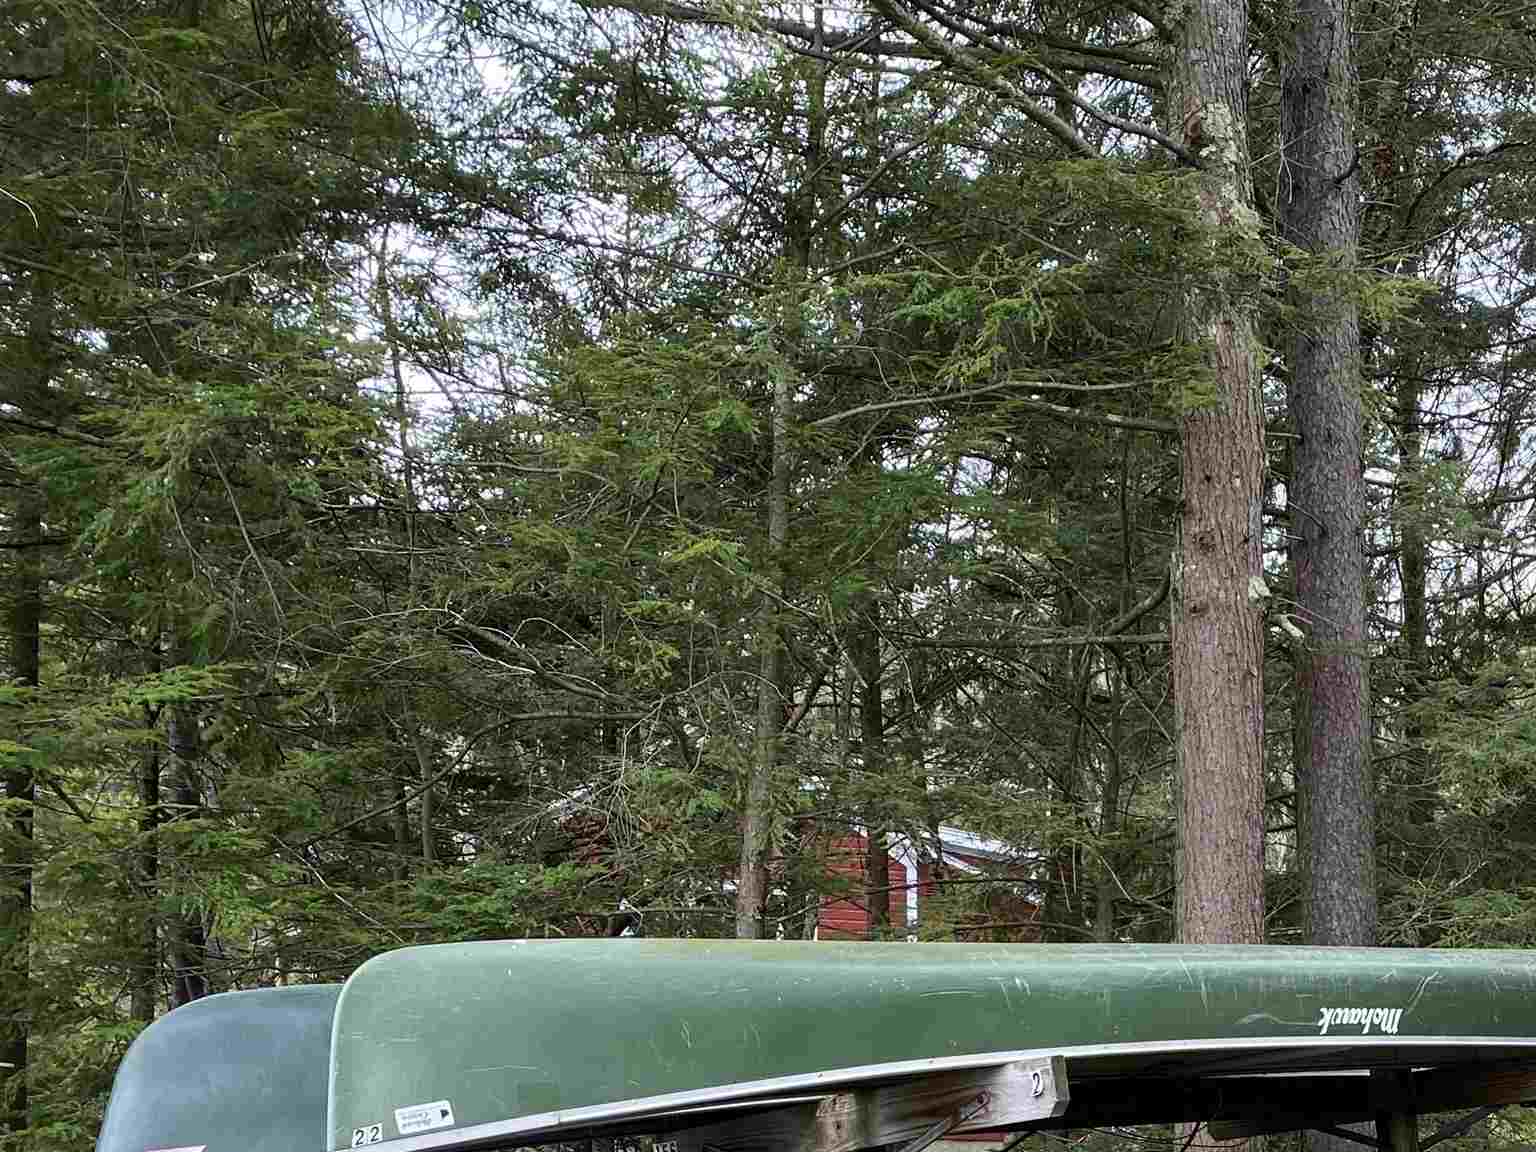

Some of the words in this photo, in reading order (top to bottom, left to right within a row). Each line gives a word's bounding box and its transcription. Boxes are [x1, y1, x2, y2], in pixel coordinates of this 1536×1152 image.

[1318, 1007, 1404, 1035] Mohawk
[1032, 1072, 1042, 1095] 2
[354, 1126, 380, 1146] 22
